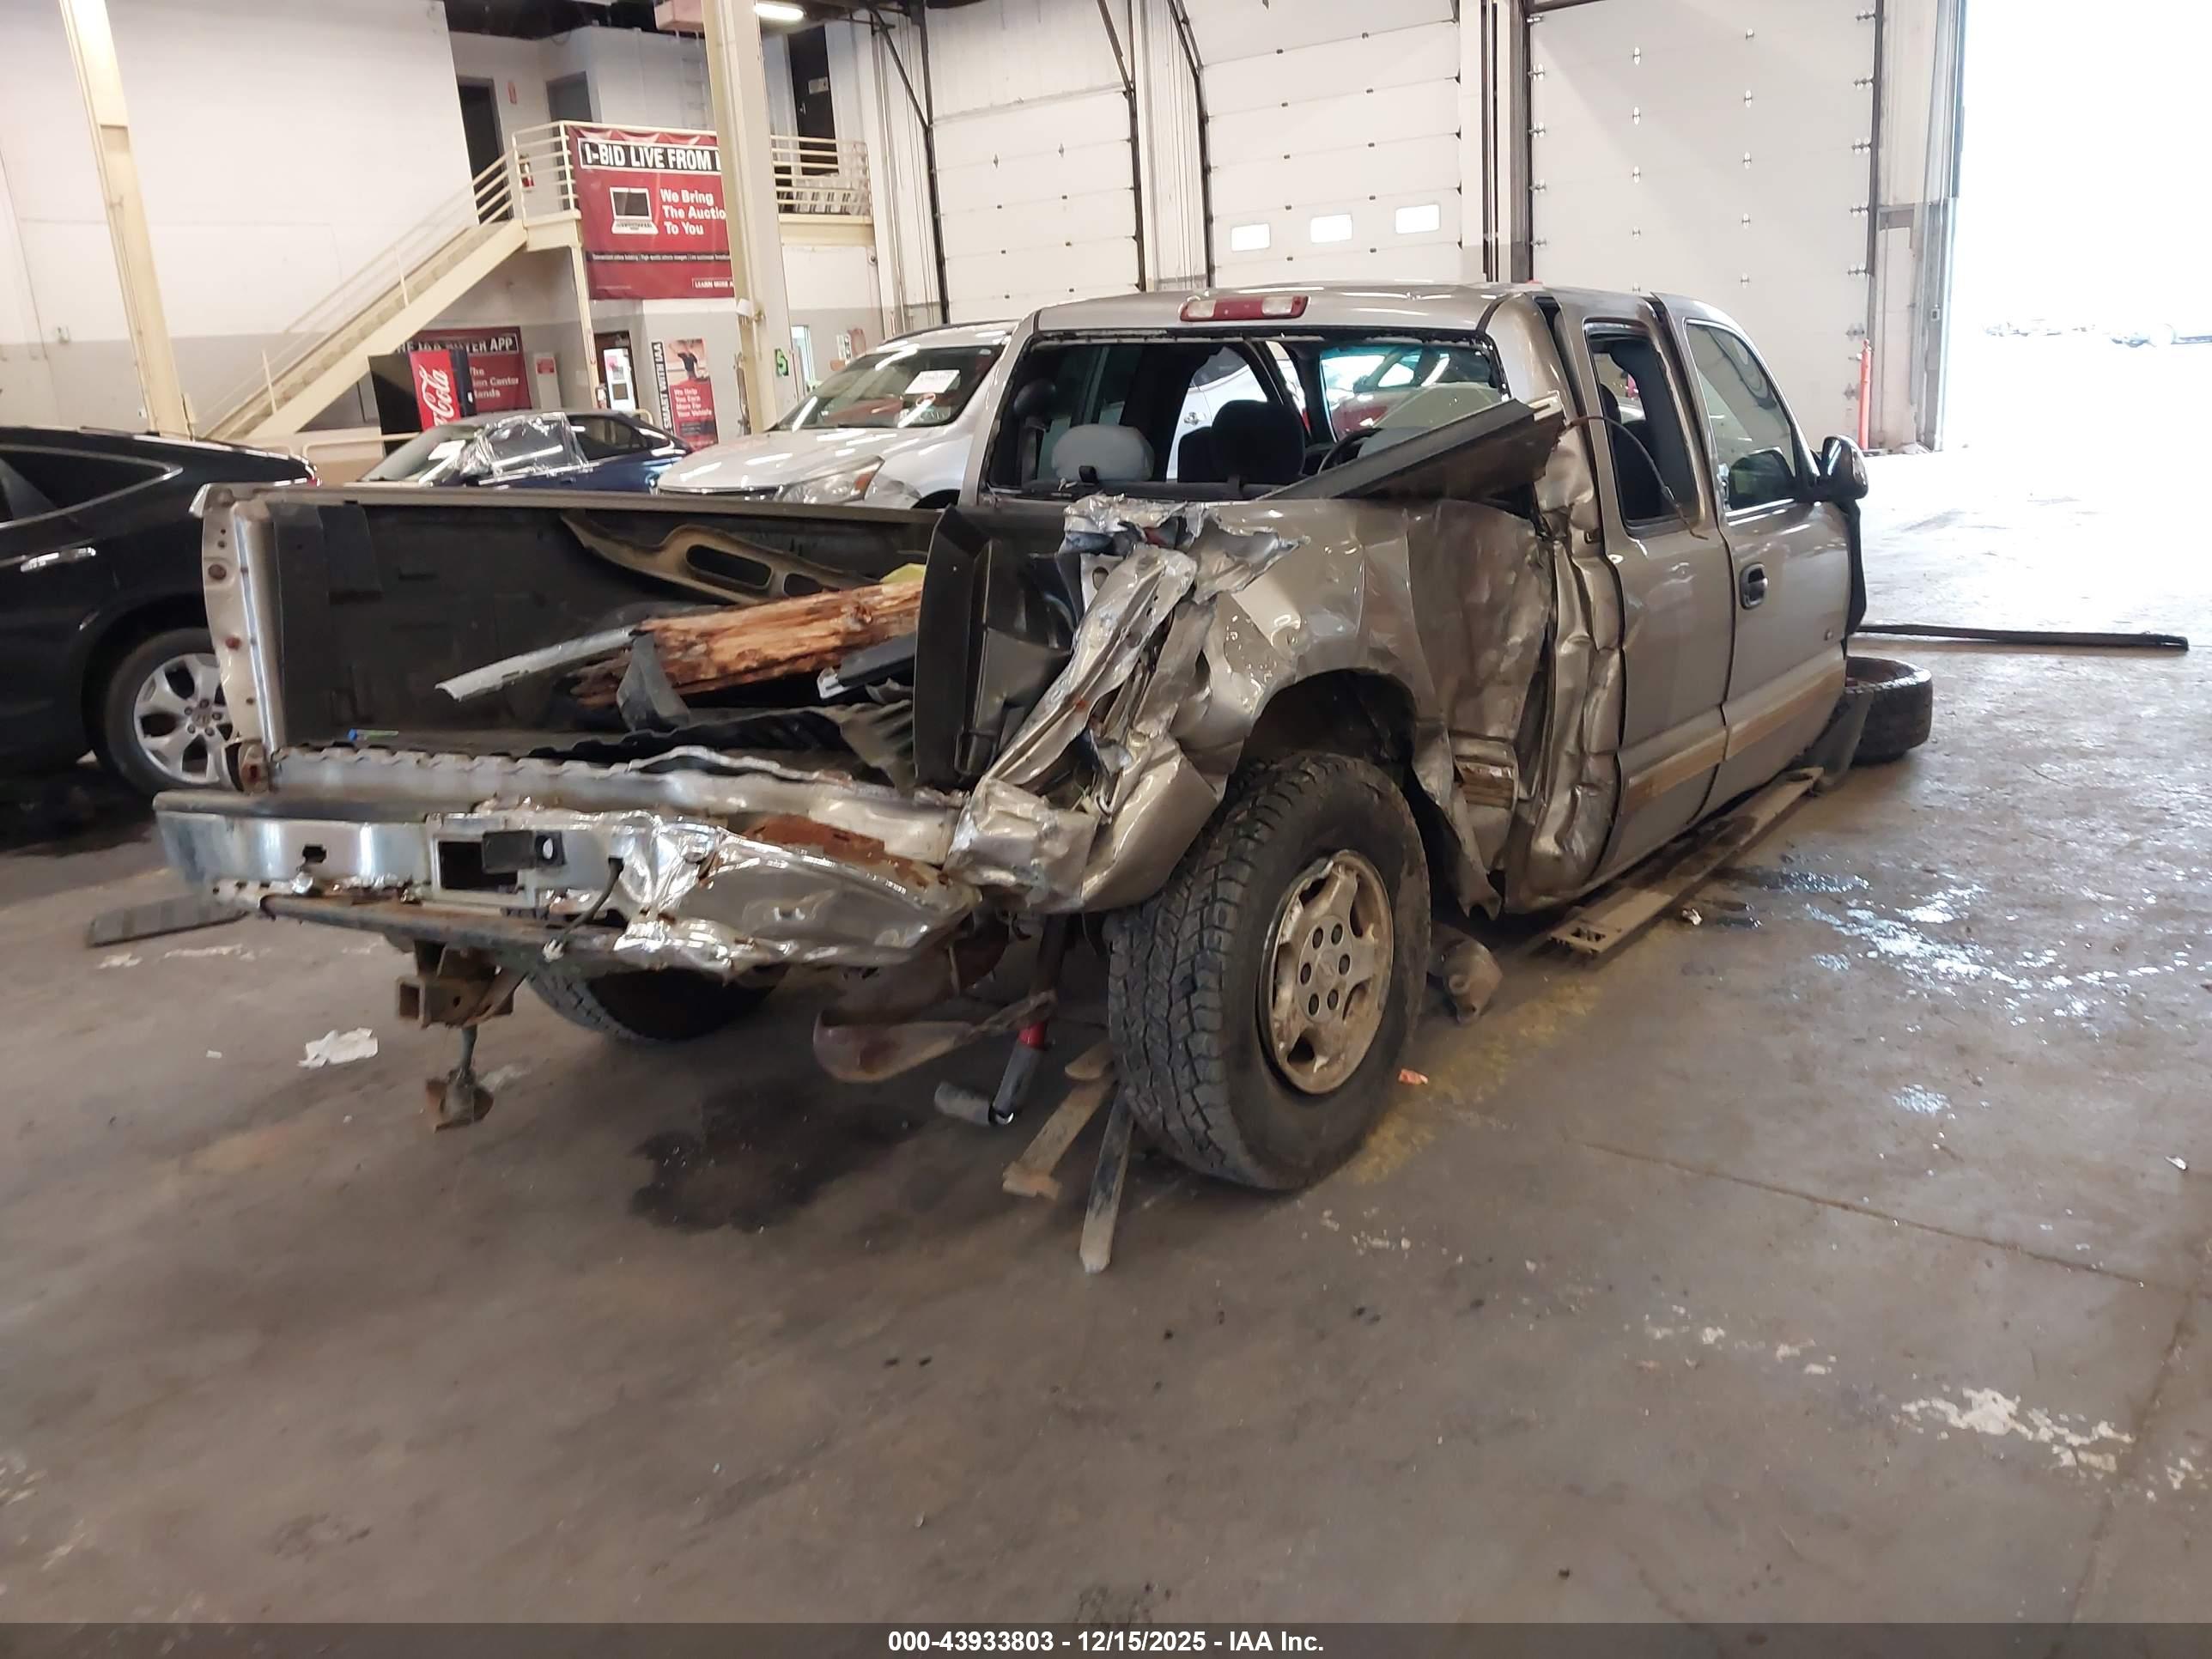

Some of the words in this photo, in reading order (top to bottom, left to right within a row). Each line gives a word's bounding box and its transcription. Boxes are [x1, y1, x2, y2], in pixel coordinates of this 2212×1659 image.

[585, 143, 625, 167] I-BID
[629, 146, 665, 168] LIVE
[668, 149, 712, 171] FROM
[660, 188, 680, 203] We
[682, 189, 714, 207] Bring
[662, 205, 685, 218] The
[688, 206, 726, 220] Auctio
[665, 222, 679, 234] To
[683, 222, 704, 235] You
[489, 336, 514, 351] APP
[653, 343, 664, 362] IAA
[489, 377, 519, 386] Center
[655, 364, 668, 392] WITH
[418, 364, 454, 418] Cola
